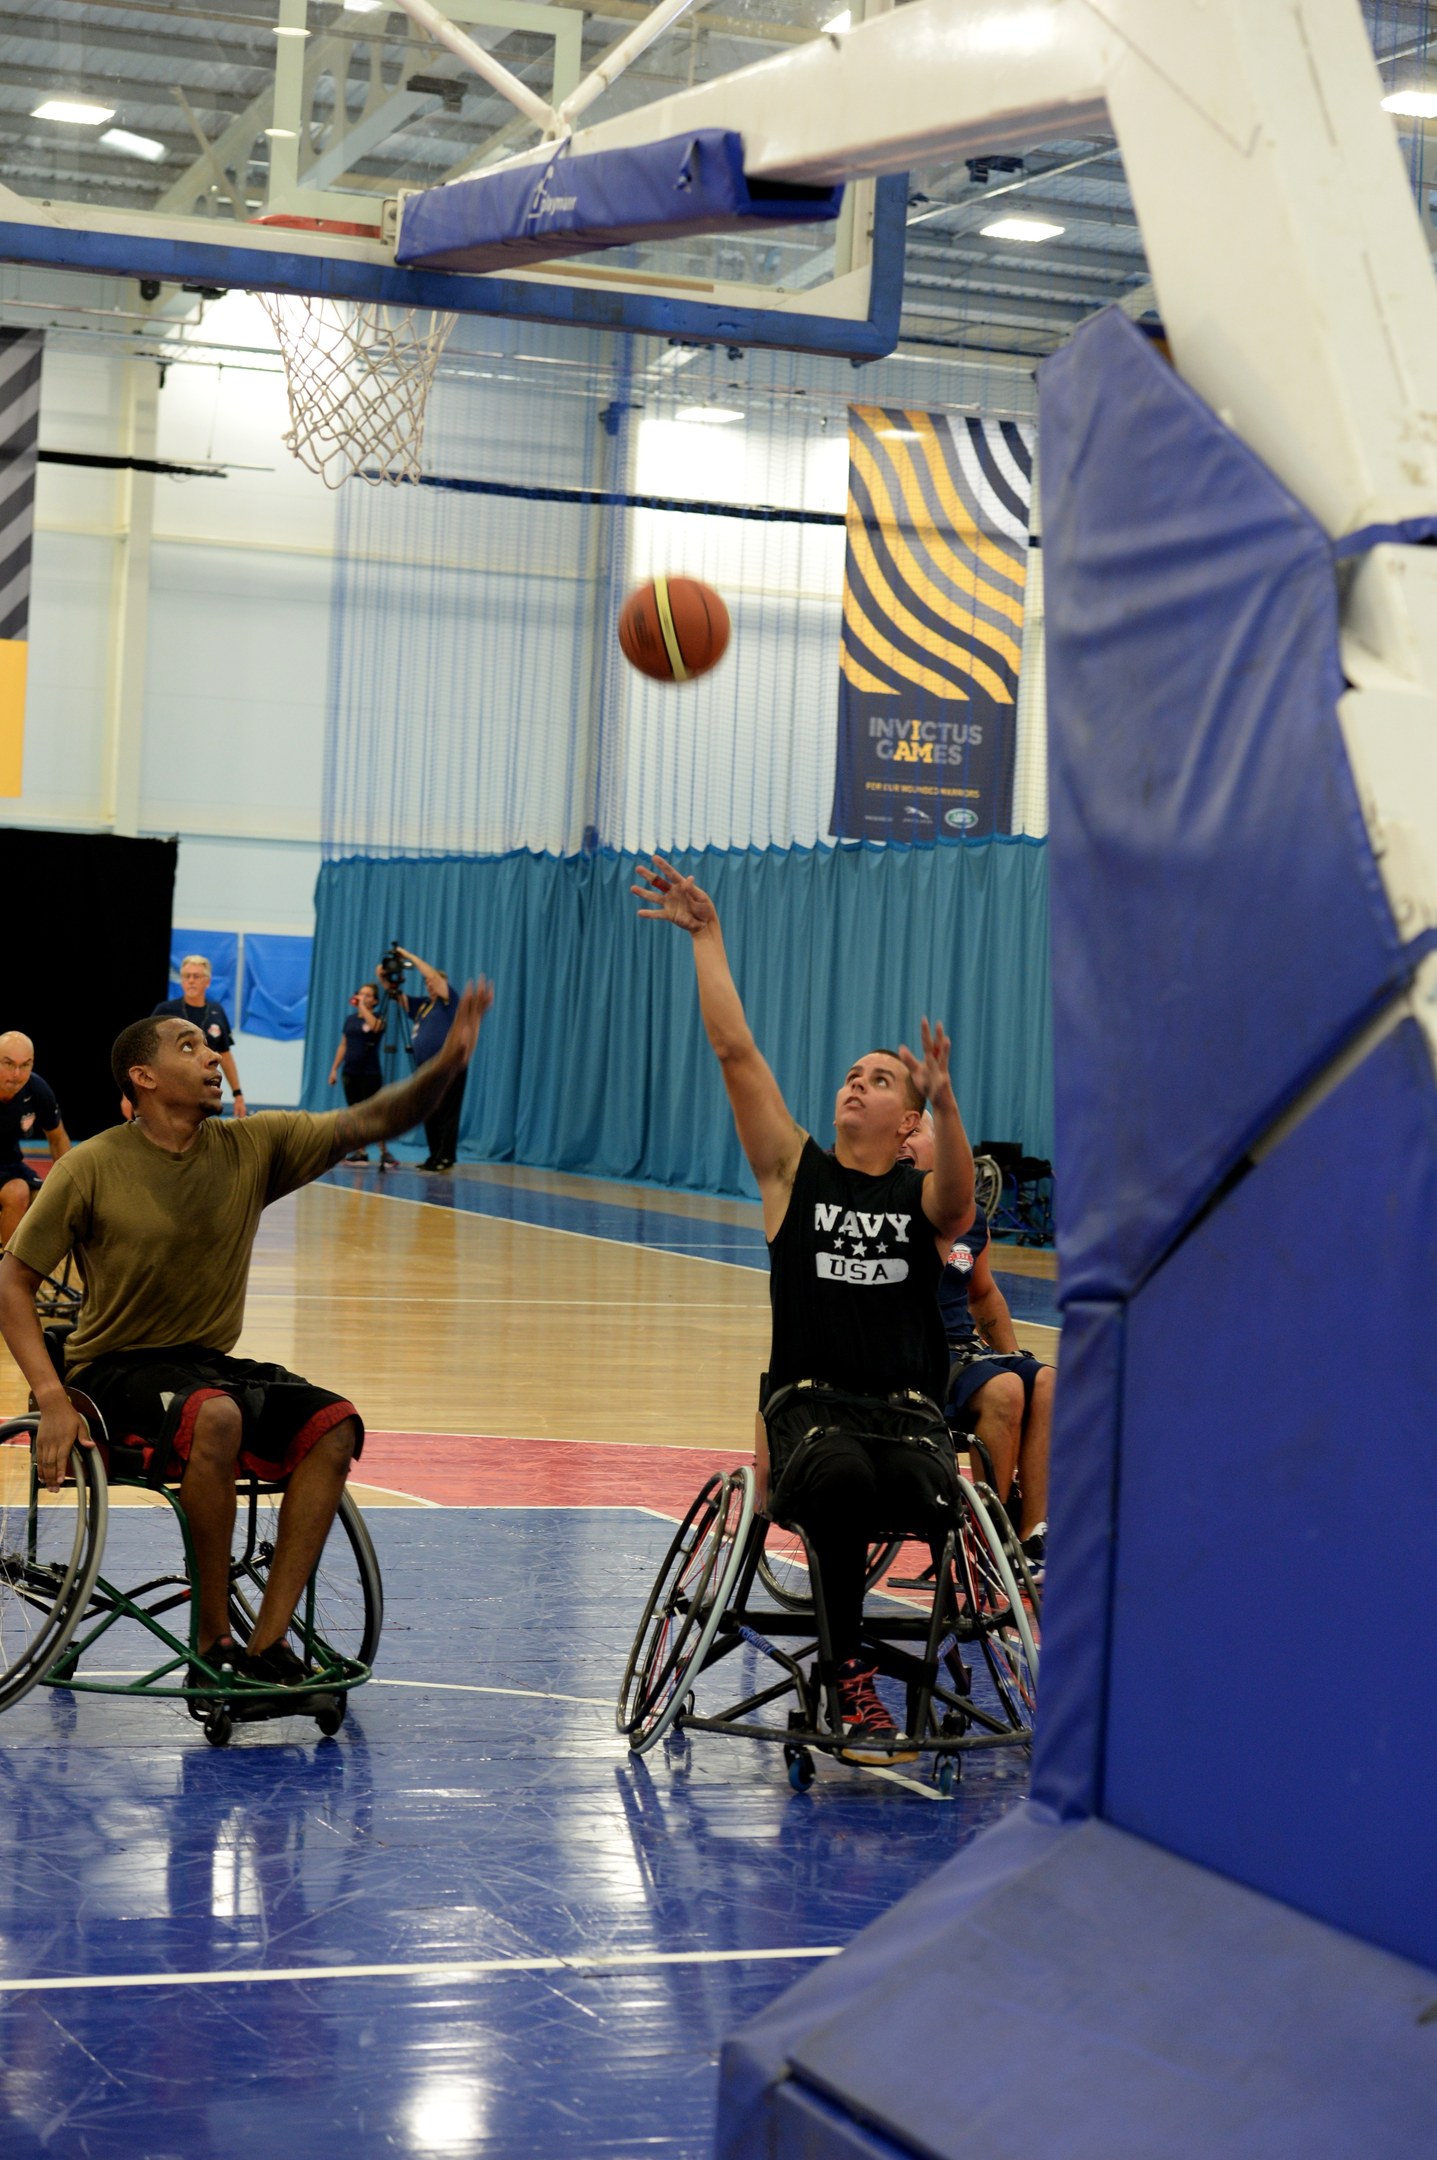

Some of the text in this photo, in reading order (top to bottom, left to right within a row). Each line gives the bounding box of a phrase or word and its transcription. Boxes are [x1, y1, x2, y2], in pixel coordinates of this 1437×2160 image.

[869, 717, 982, 745] INVICTUS
[876, 739, 962, 765] GAMES
[815, 1203, 911, 1242] NAVY
[830, 1258, 889, 1282] USA
